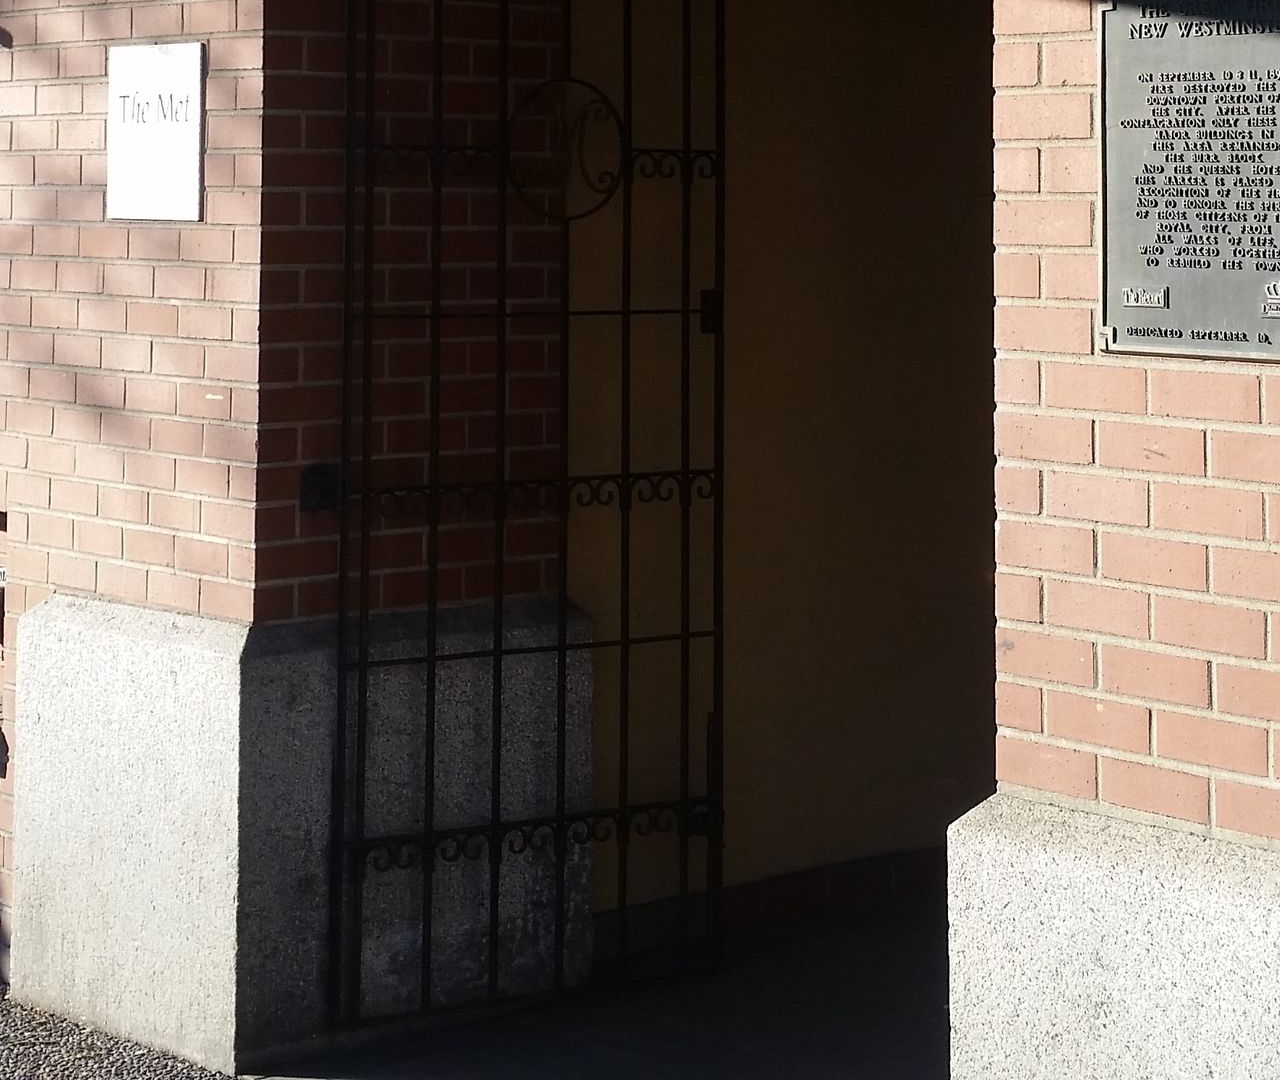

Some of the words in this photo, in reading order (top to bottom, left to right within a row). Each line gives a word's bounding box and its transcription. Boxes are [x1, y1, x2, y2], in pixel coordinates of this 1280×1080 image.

[1138, 3, 1170, 18] THE
[1129, 23, 1168, 39] NEW
[1137, 72, 1153, 83] ON
[1157, 71, 1214, 81] SEPTEMBER
[1222, 70, 1231, 80] 10
[1150, 84, 1173, 94] FIRE
[1183, 84, 1246, 93] DESTROYED
[1255, 82, 1276, 92] THE
[1146, 95, 1207, 105] DOWNTOWN
[1214, 94, 1263, 104] PORTION
[1267, 94, 1280, 103] OF
[119, 90, 150, 124] The
[157, 92, 190, 123] Met
[1149, 107, 1169, 117] THE
[1216, 106, 1250, 115] AFTER
[1254, 106, 1276, 115] THE
[1120, 119, 1205, 128] CONFLAGRATION
[1211, 119, 1240, 128] ONLY
[1244, 118, 1276, 127] THESE
[1154, 130, 1190, 139] MAJOR
[1196, 130, 1253, 139] BUILDINGS
[1261, 130, 1274, 139] IN
[1151, 141, 1174, 151] THIS
[1183, 141, 1212, 151] AREA
[1163, 153, 1184, 163] THE
[1228, 154, 1264, 163] BLOCK
[1142, 164, 1164, 174] AND
[1174, 164, 1192, 174] THE
[1199, 165, 1241, 175] QUEENS
[1133, 176, 1156, 186] THIS
[1163, 176, 1207, 186] MARKER
[1215, 177, 1225, 186] IS
[1232, 177, 1273, 187] PLACED
[1137, 187, 1209, 197] RECOGNITION
[1216, 188, 1231, 197] OF
[1239, 188, 1261, 198] THE
[1136, 198, 1158, 208] AND
[1164, 199, 1177, 209] TO
[1183, 199, 1227, 209] HONOUR
[1233, 200, 1254, 210] THE
[1135, 210, 1149, 219] OF
[1155, 210, 1187, 220] THOSE
[1195, 211, 1247, 222] CITIZENS
[1253, 212, 1268, 222] OF
[1156, 223, 1192, 232] ROYAL
[1240, 224, 1272, 234] FROM
[1154, 234, 1174, 244] ALL
[1183, 235, 1218, 245] WALKS
[1227, 236, 1242, 246] OF
[1139, 245, 1164, 255] WHO
[1174, 246, 1220, 257] WORKED
[1146, 257, 1159, 267] TO
[1166, 258, 1211, 268] REBUILD
[1220, 259, 1242, 270] THE
[1123, 287, 1138, 304] The
[1126, 327, 1183, 338] DEDICATED
[1188, 330, 1248, 342] SEPTEMBER
